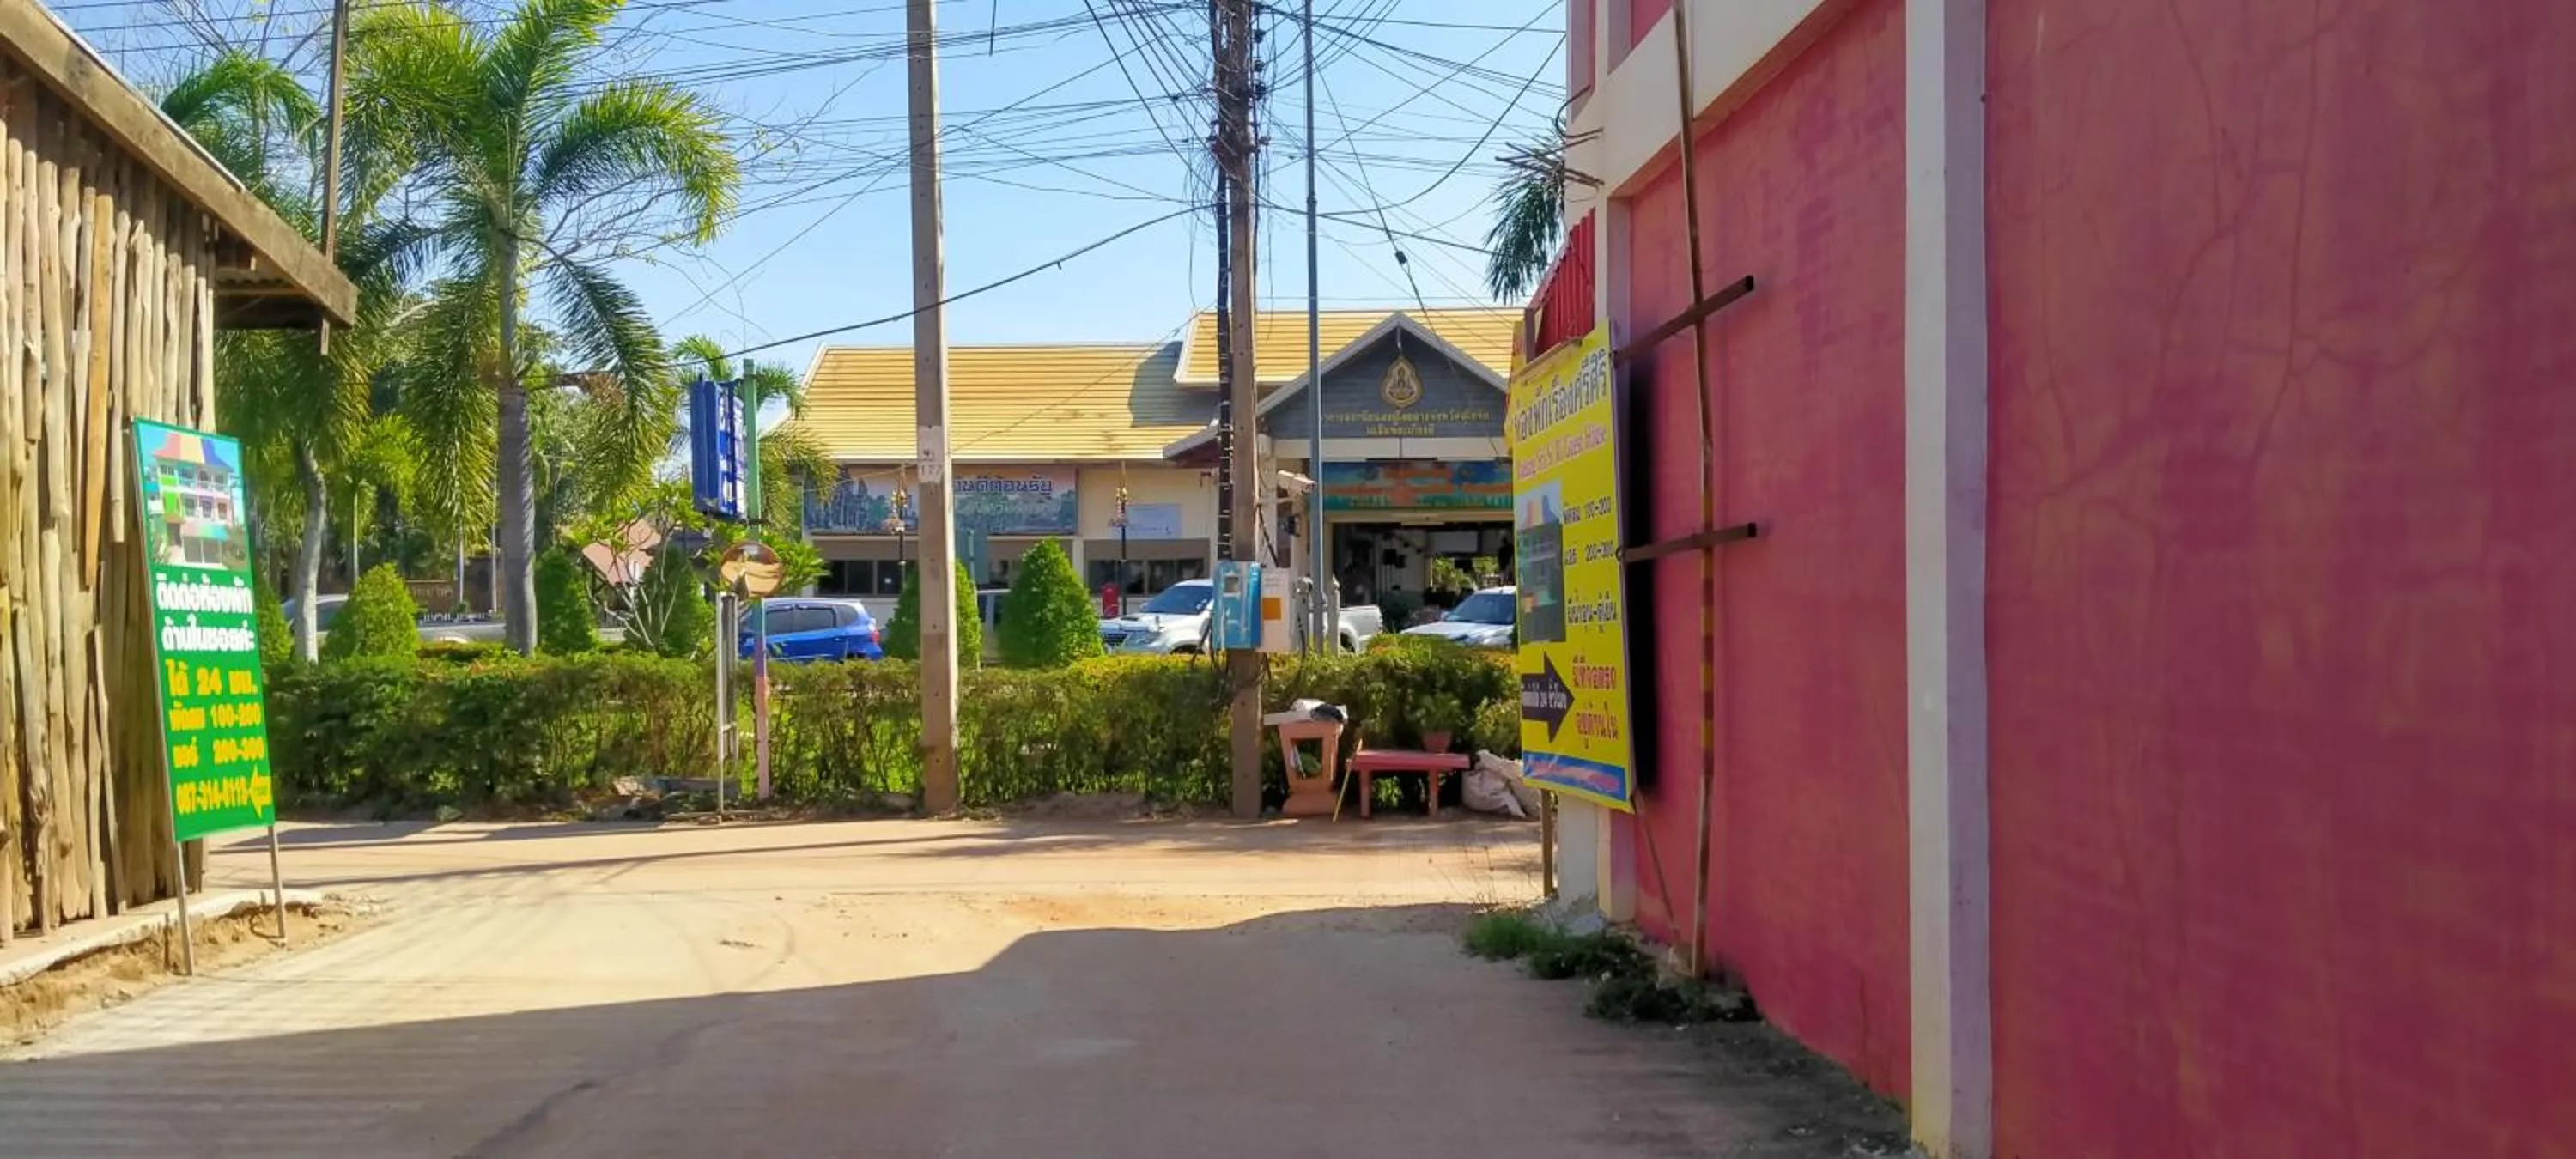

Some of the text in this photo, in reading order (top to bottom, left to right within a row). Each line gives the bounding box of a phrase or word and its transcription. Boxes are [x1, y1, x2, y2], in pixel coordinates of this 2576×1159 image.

[155, 572, 253, 614] ติดต่อห้องพัก
[197, 667, 222, 695] 24
[210, 701, 262, 729] 100-200
